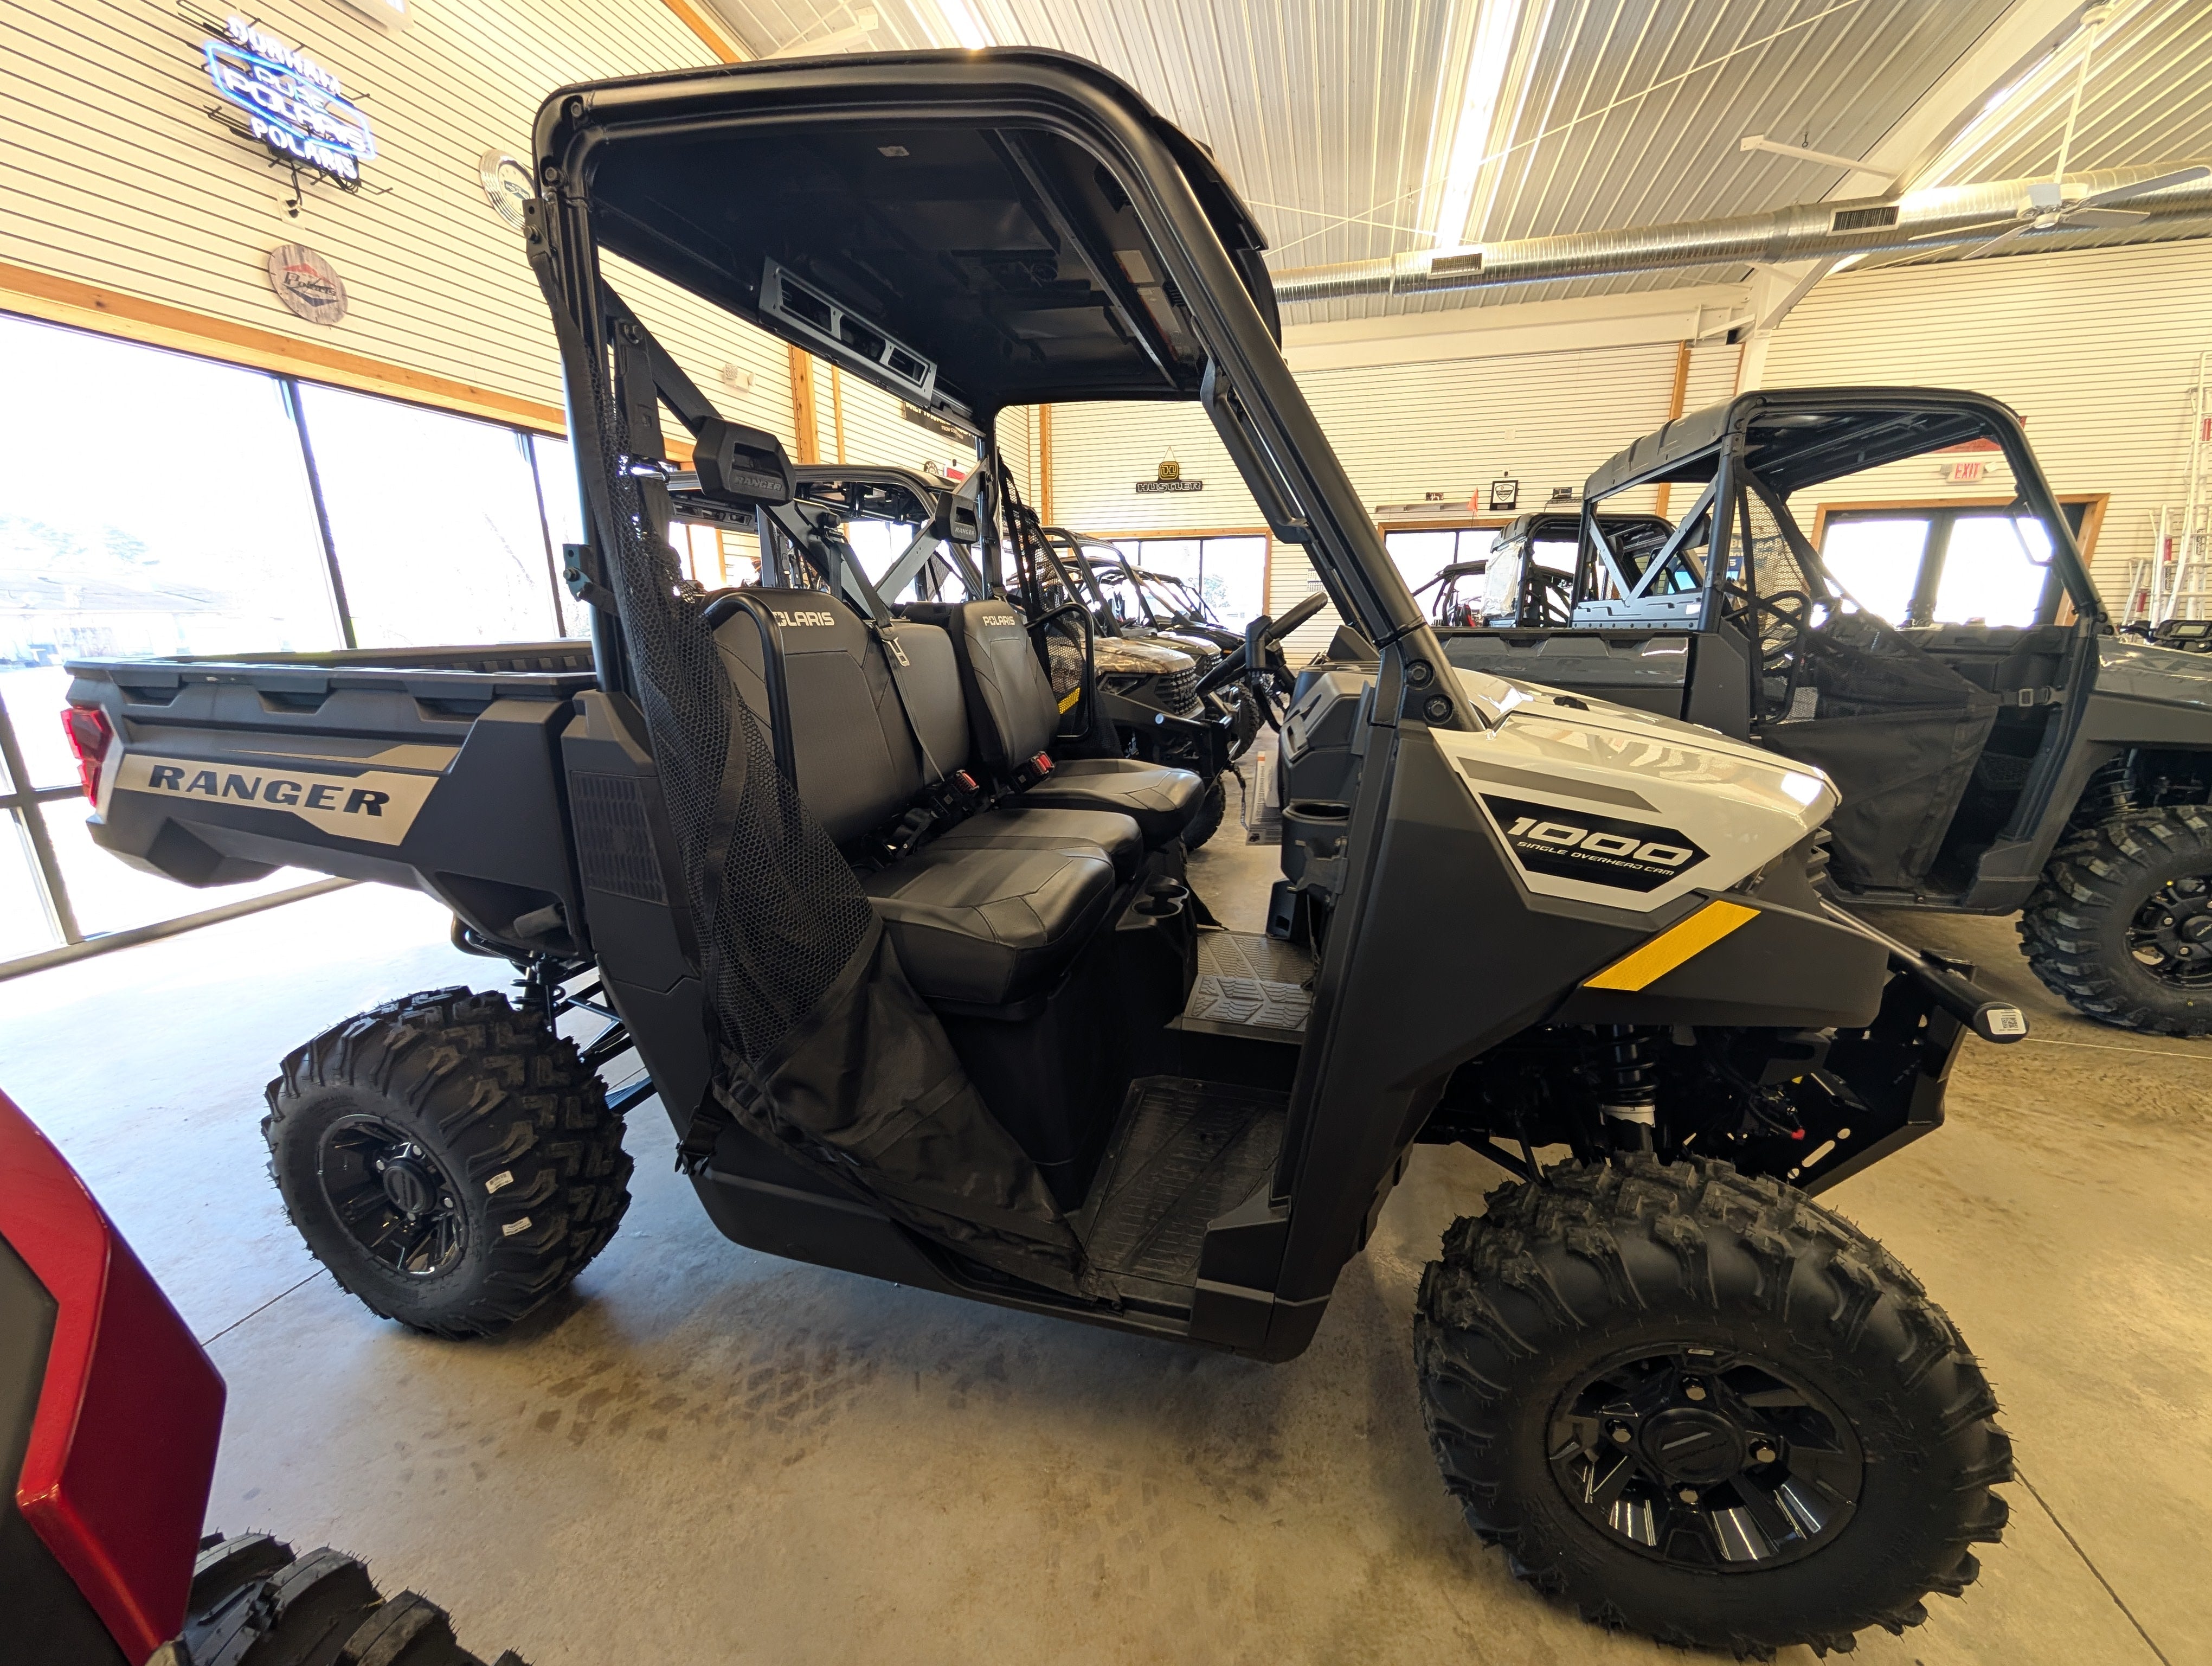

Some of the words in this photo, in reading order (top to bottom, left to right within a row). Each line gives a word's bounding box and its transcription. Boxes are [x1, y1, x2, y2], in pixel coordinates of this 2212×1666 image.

[227, 16, 341, 95] DURHAM
[254, 65, 329, 114] PURE
[223, 67, 366, 152] POLARIS
[250, 116, 358, 180] POLARIS
[735, 475, 782, 491] RANGER
[1137, 481, 1201, 492] HUSTLER
[1954, 463, 1981, 479] EXIT
[955, 527, 975, 536] RANGER
[772, 611, 835, 626] OLARIS
[982, 616, 1015, 626] POLARIS
[148, 764, 390, 817] RANGER
[1507, 817, 1693, 867] 1000
[1517, 841, 1568, 855] SINGLE
[1571, 853, 1643, 870] OVERHEAD
[1644, 866, 1675, 876] CAM
